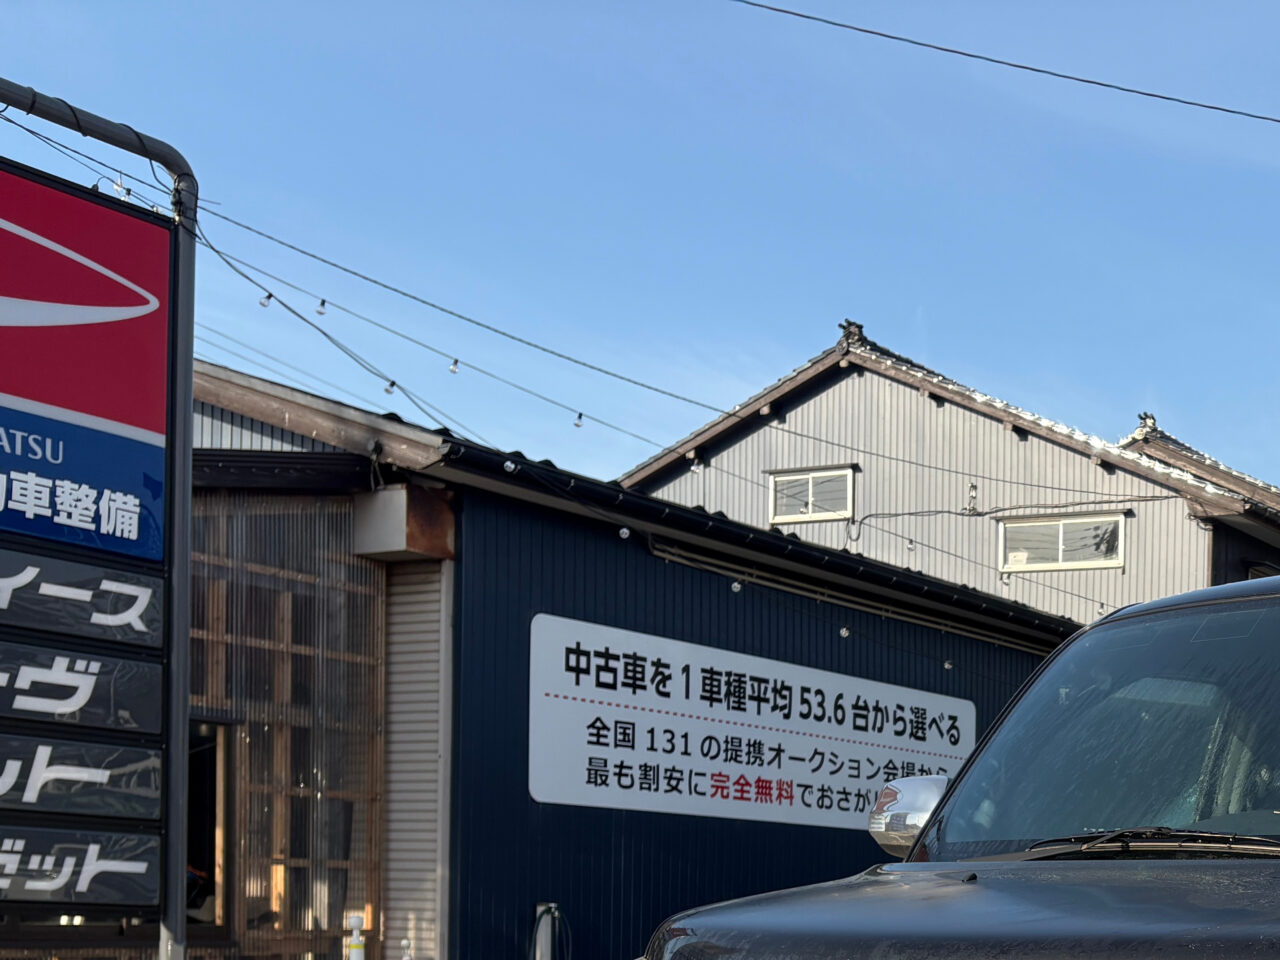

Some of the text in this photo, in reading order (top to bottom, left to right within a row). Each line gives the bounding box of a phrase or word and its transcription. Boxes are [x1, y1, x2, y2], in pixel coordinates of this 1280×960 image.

[0, 471, 140, 541] 車整備
[0, 656, 102, 715] ヴ
[585, 757, 879, 813] 最も割安に完全無料でおさが
